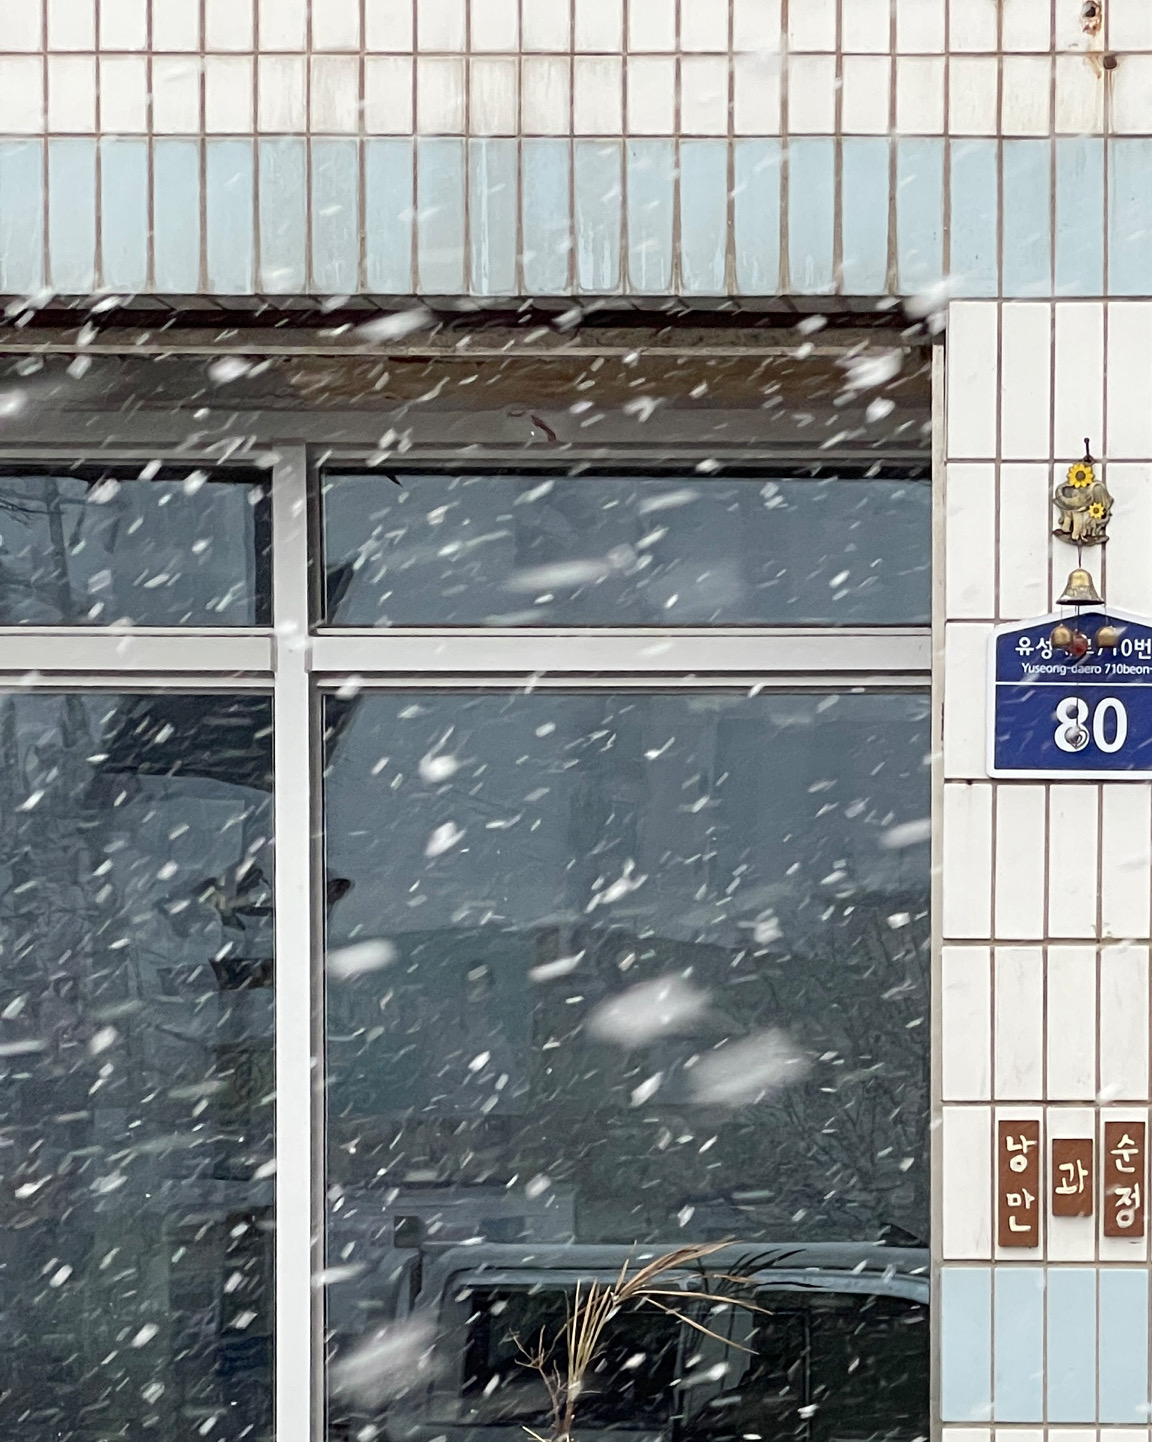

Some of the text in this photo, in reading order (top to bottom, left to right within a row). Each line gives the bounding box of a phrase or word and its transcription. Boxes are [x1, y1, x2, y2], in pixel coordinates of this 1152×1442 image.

[1021, 662, 1102, 675] Yuseong-daero
[1054, 696, 1128, 753] 80
[1005, 1133, 1141, 1232] 낭만 과 순정
